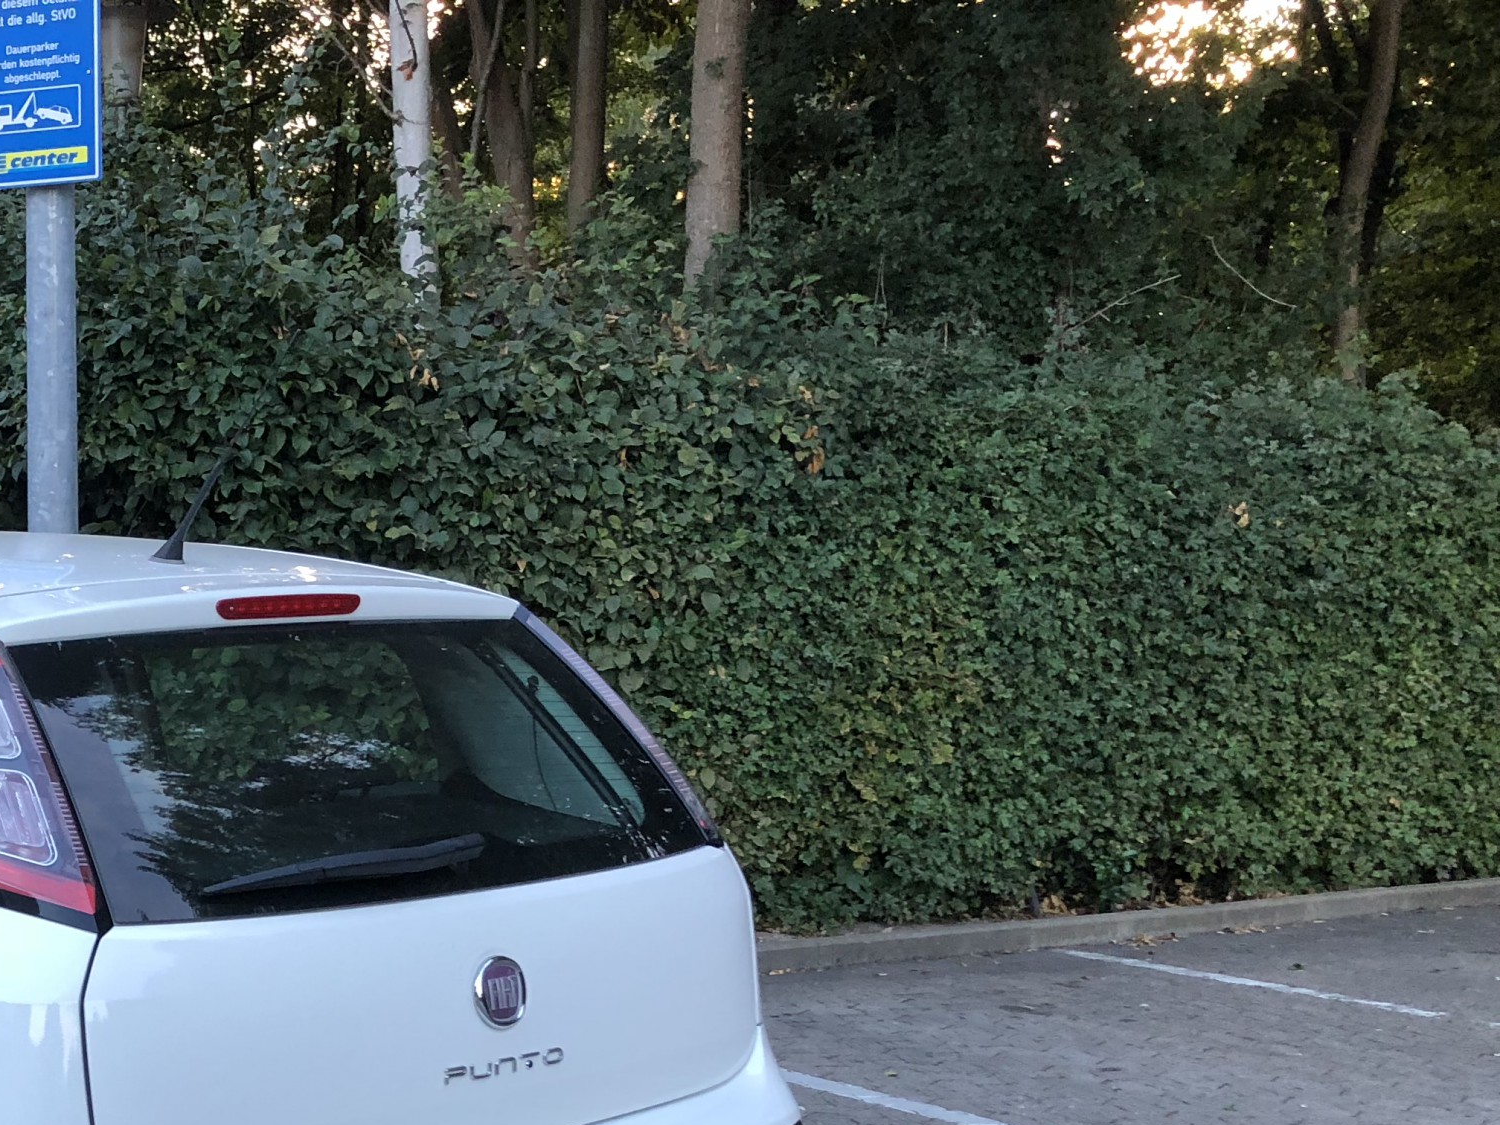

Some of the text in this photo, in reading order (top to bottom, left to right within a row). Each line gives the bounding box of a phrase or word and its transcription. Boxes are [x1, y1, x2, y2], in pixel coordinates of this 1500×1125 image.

[7, 14, 23, 26] die
[26, 12, 48, 26] allg.
[51, 7, 77, 22] StVO
[5, 41, 60, 56] Dauerparker
[19, 53, 81, 67] kostenpflichtig
[4, 69, 62, 85] abgeschleppt.
[10, 151, 78, 168] center
[443, 1047, 564, 1086] PUNTO
